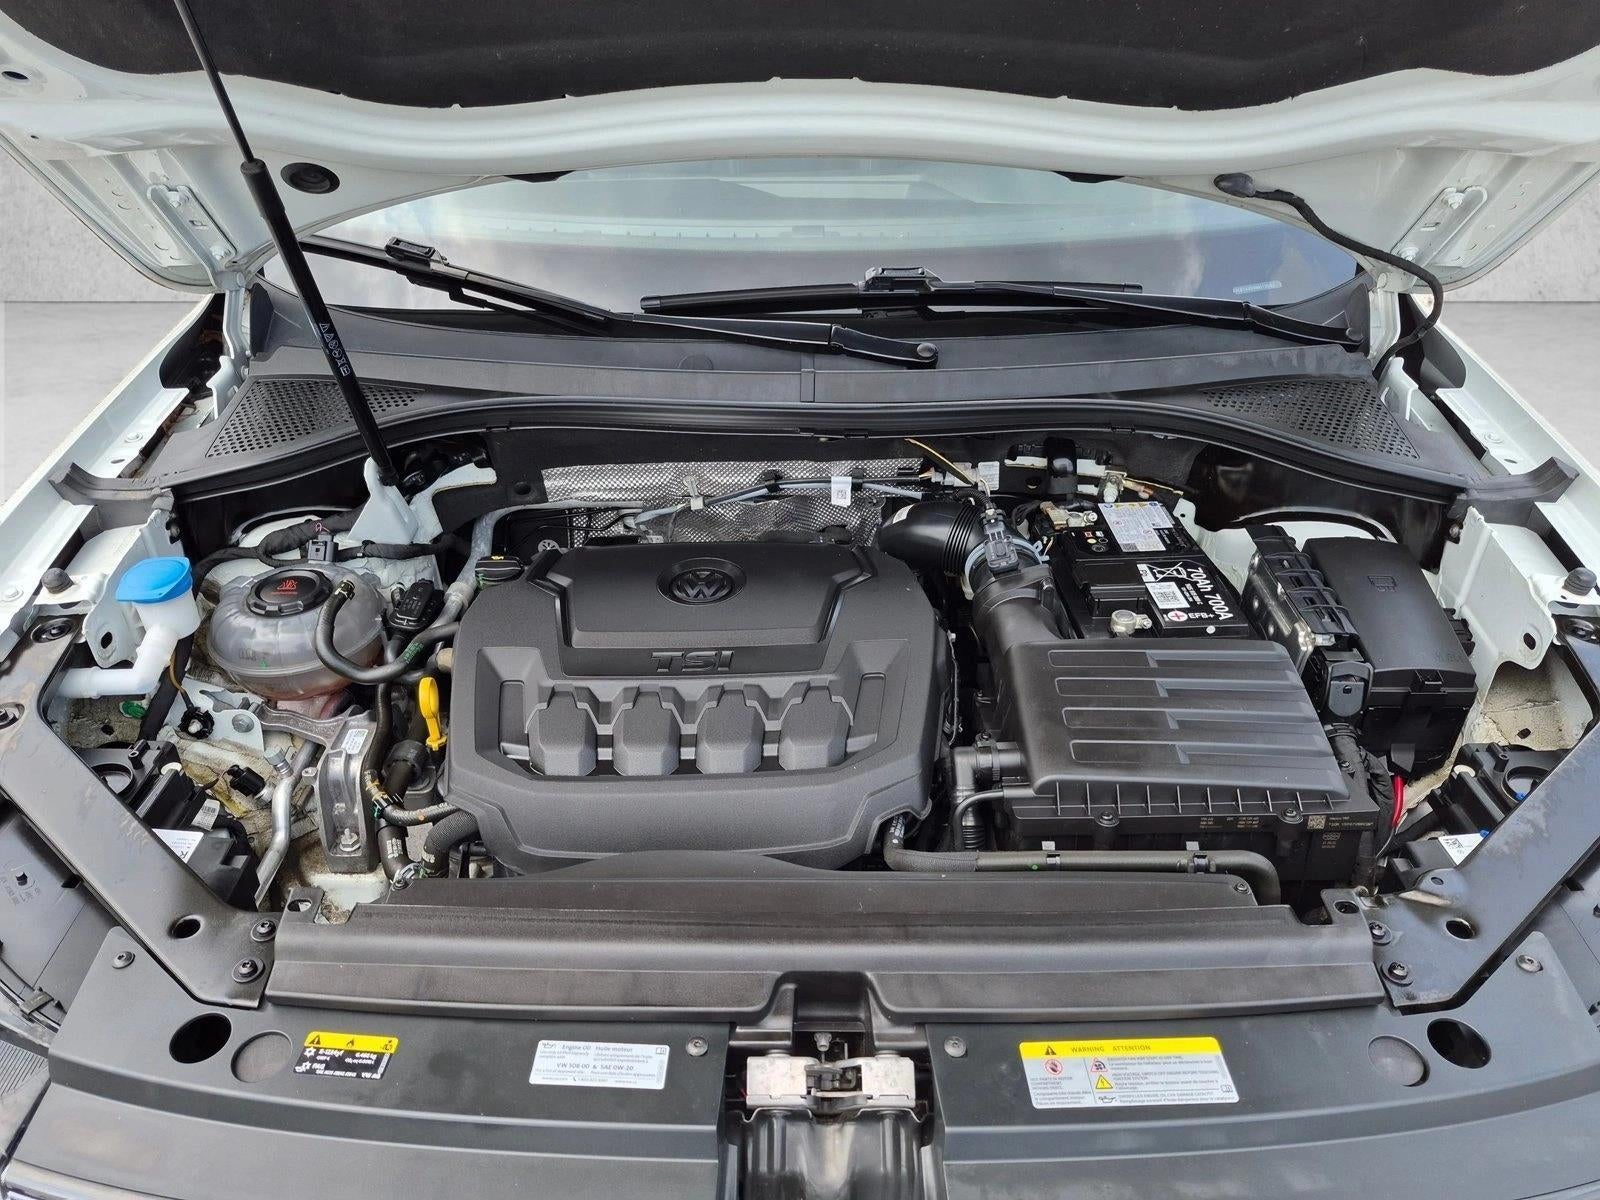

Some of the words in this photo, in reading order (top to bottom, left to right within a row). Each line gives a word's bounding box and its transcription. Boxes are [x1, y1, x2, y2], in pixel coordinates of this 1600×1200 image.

[1187, 567, 1215, 592] 70Ah
[1204, 593, 1234, 620] 700A
[651, 651, 734, 672] TSI
[1071, 1046, 1105, 1054] WARNING
